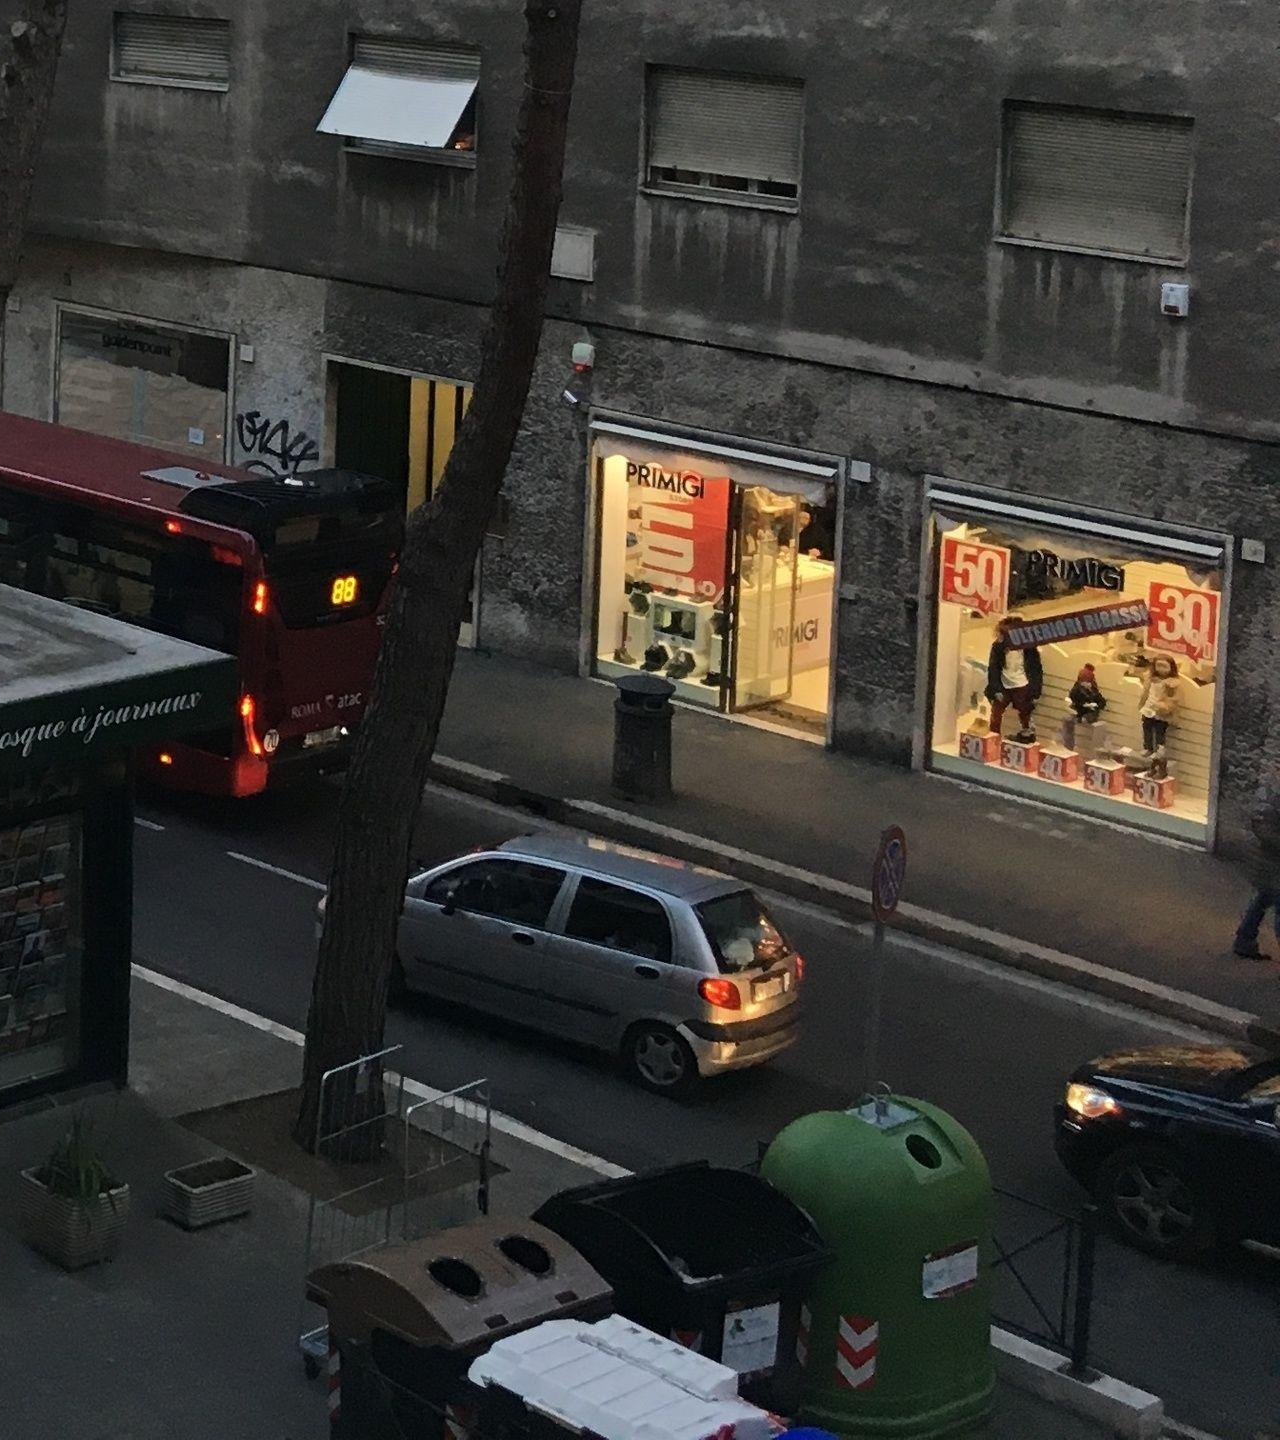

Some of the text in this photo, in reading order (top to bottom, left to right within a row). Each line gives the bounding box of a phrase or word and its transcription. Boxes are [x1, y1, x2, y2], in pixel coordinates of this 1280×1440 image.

[626, 462, 705, 499] PRIMIGI
[1029, 548, 1125, 592] PRIMIGI
[332, 576, 357, 605] 88
[70, 707, 87, 733] à
[84, 690, 204, 744] journaux
[337, 692, 362, 709] atac
